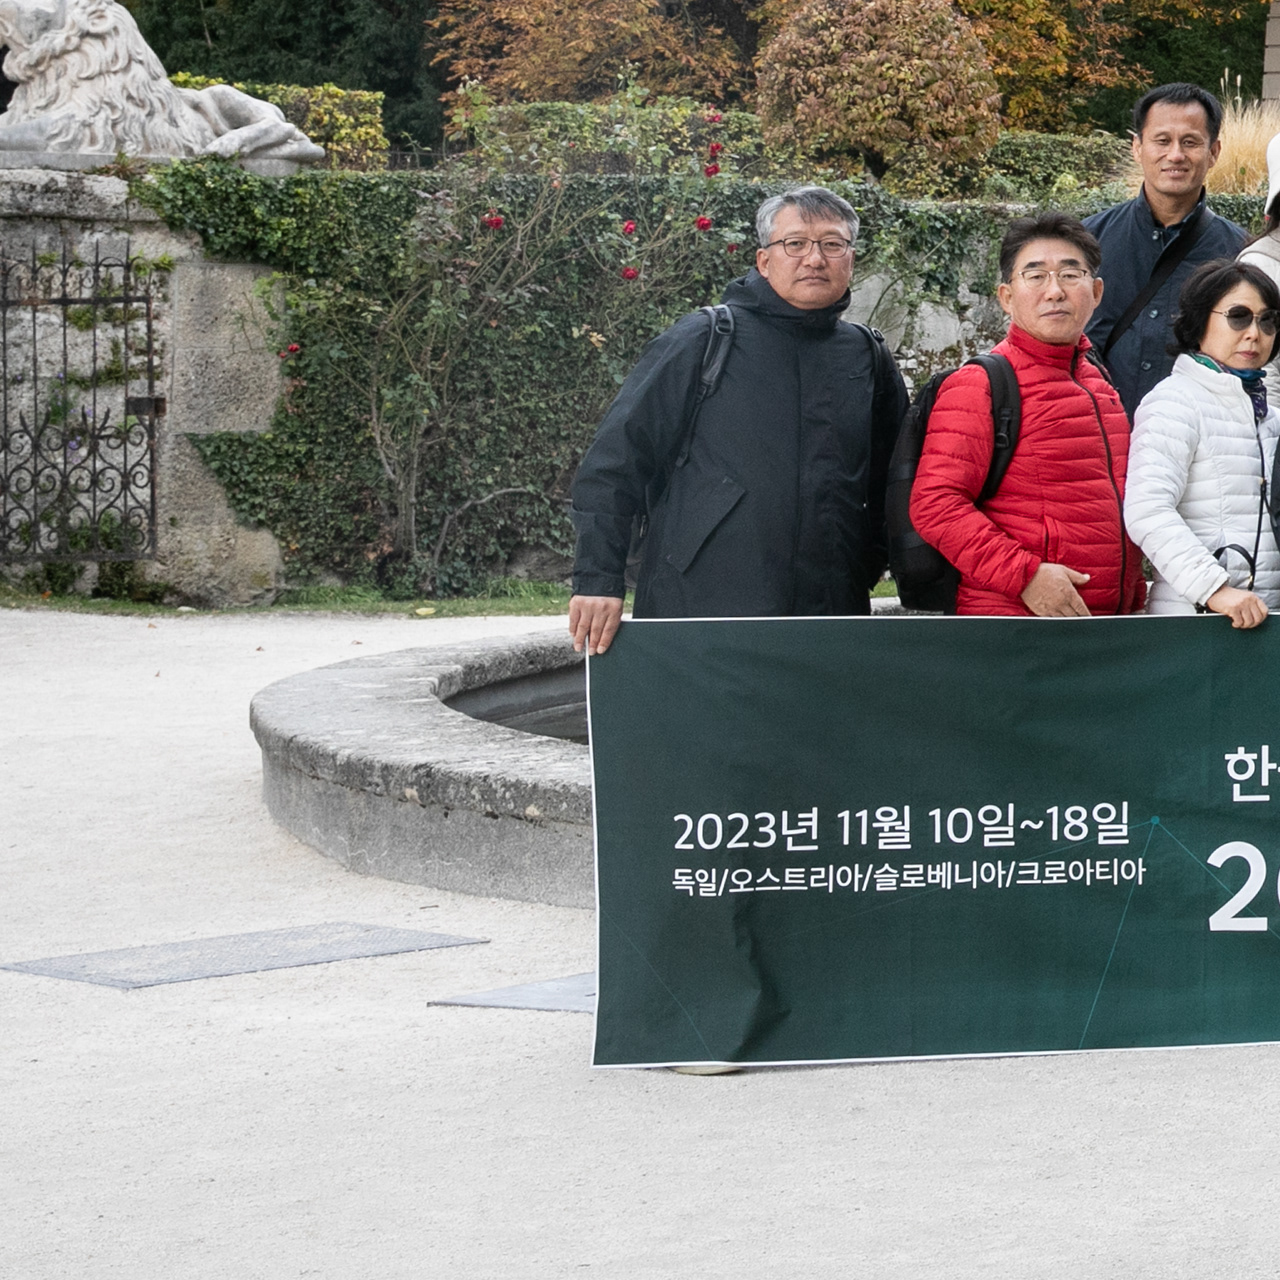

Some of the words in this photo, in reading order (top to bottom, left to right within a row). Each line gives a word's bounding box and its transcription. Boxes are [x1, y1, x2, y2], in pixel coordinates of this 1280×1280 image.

[673, 806, 819, 851] 2023년
[837, 805, 912, 850] 11월
[928, 801, 1130, 847] 10일~18일
[672, 857, 1147, 897] 독일/오스트리아/슬로베니아/크로아티아
